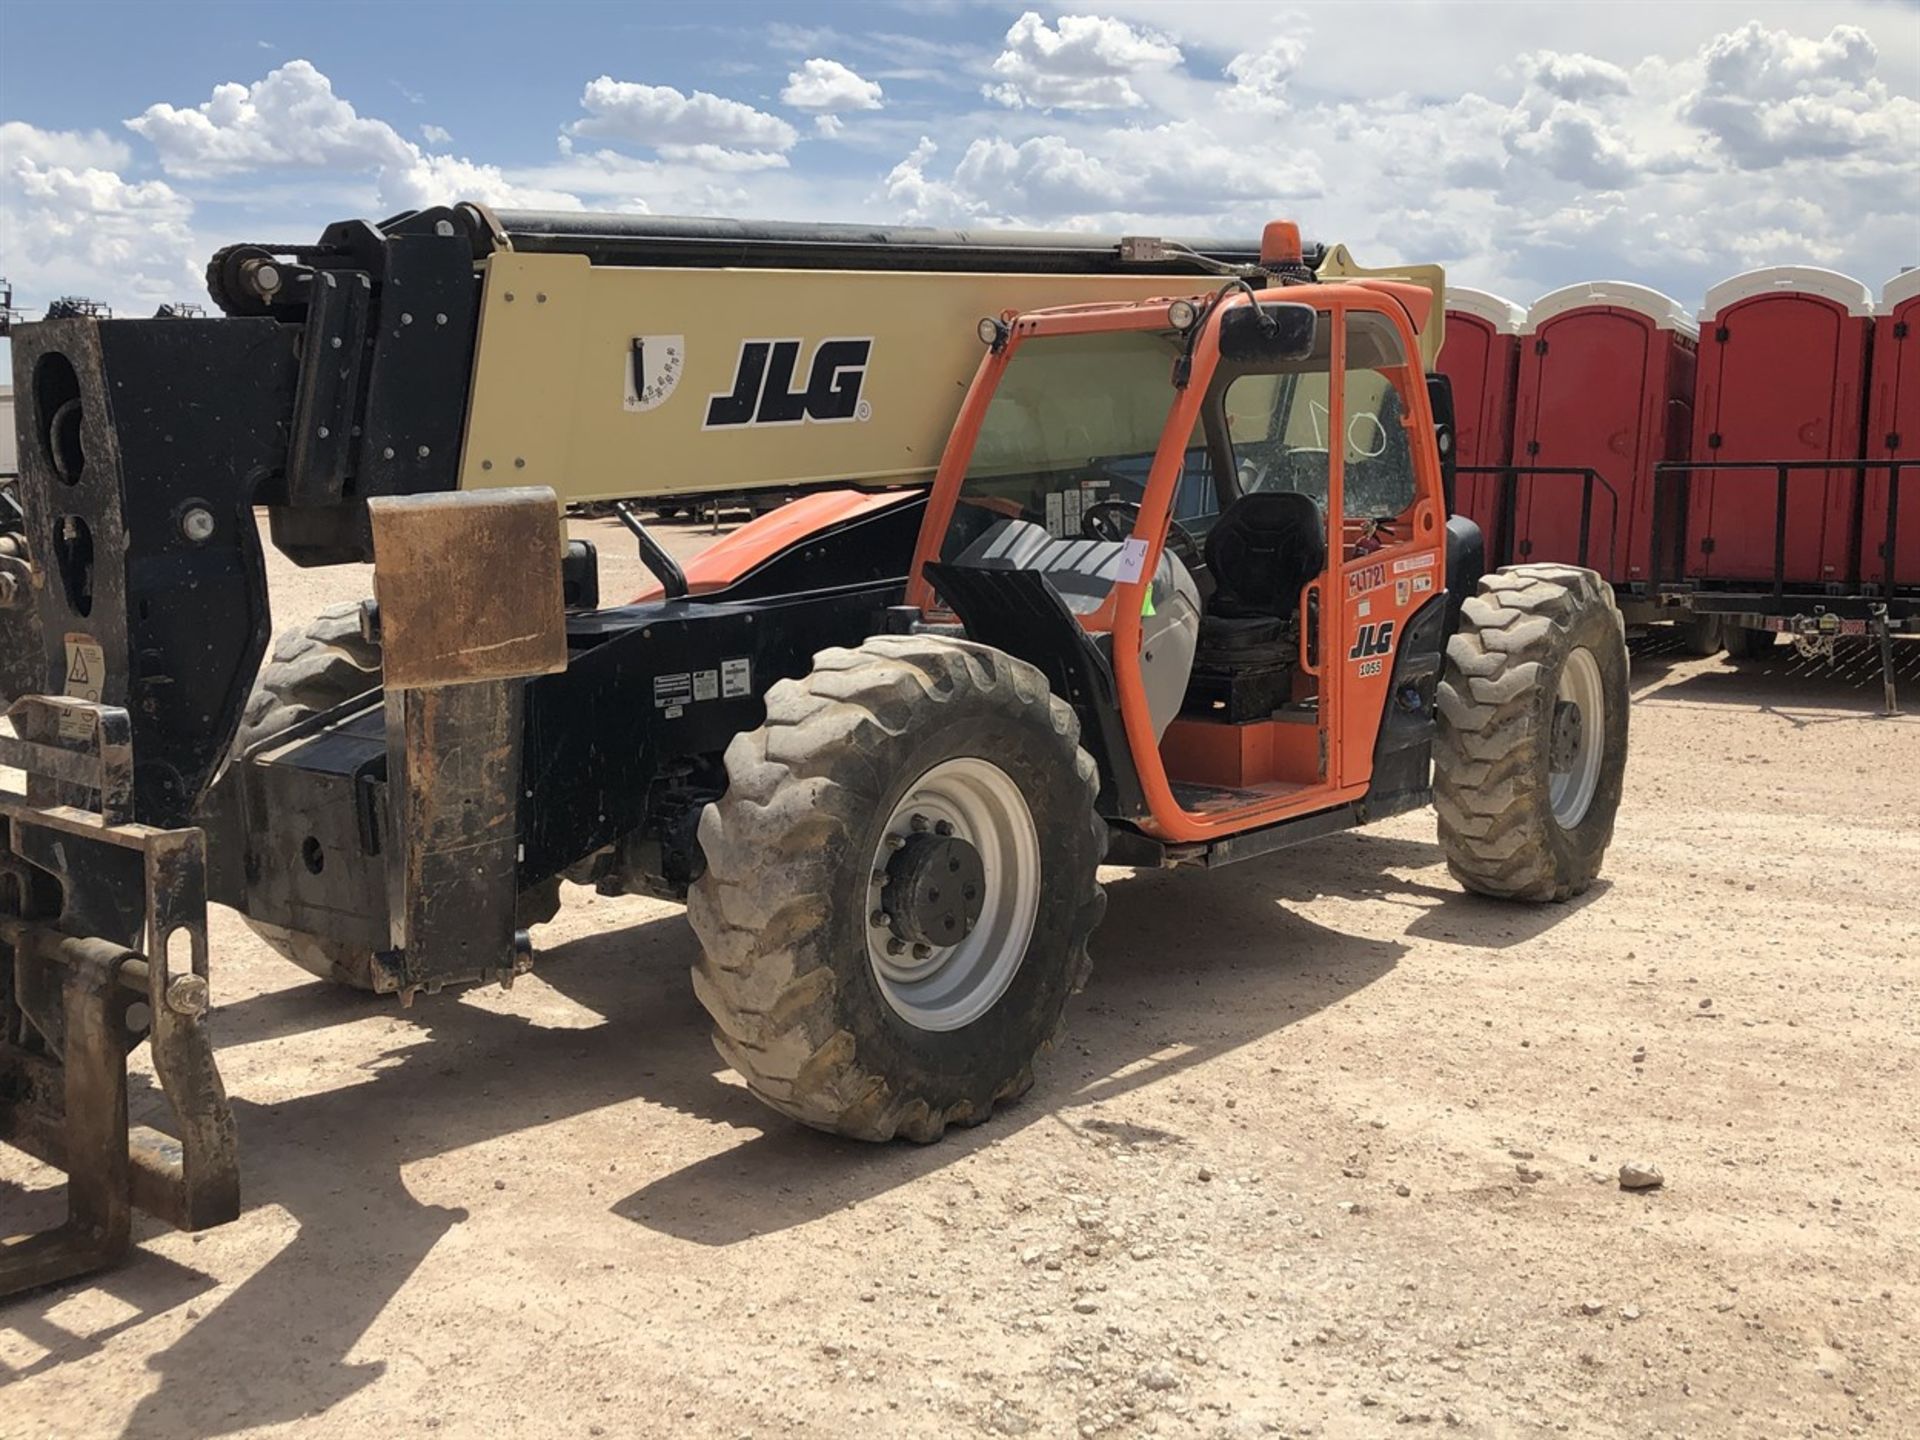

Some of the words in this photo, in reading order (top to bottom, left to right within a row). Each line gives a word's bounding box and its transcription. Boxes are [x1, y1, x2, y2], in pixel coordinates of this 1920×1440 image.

[705, 340, 872, 427] JLG
[1349, 622, 1394, 659] JLG
[1359, 661, 1381, 676] 1055
